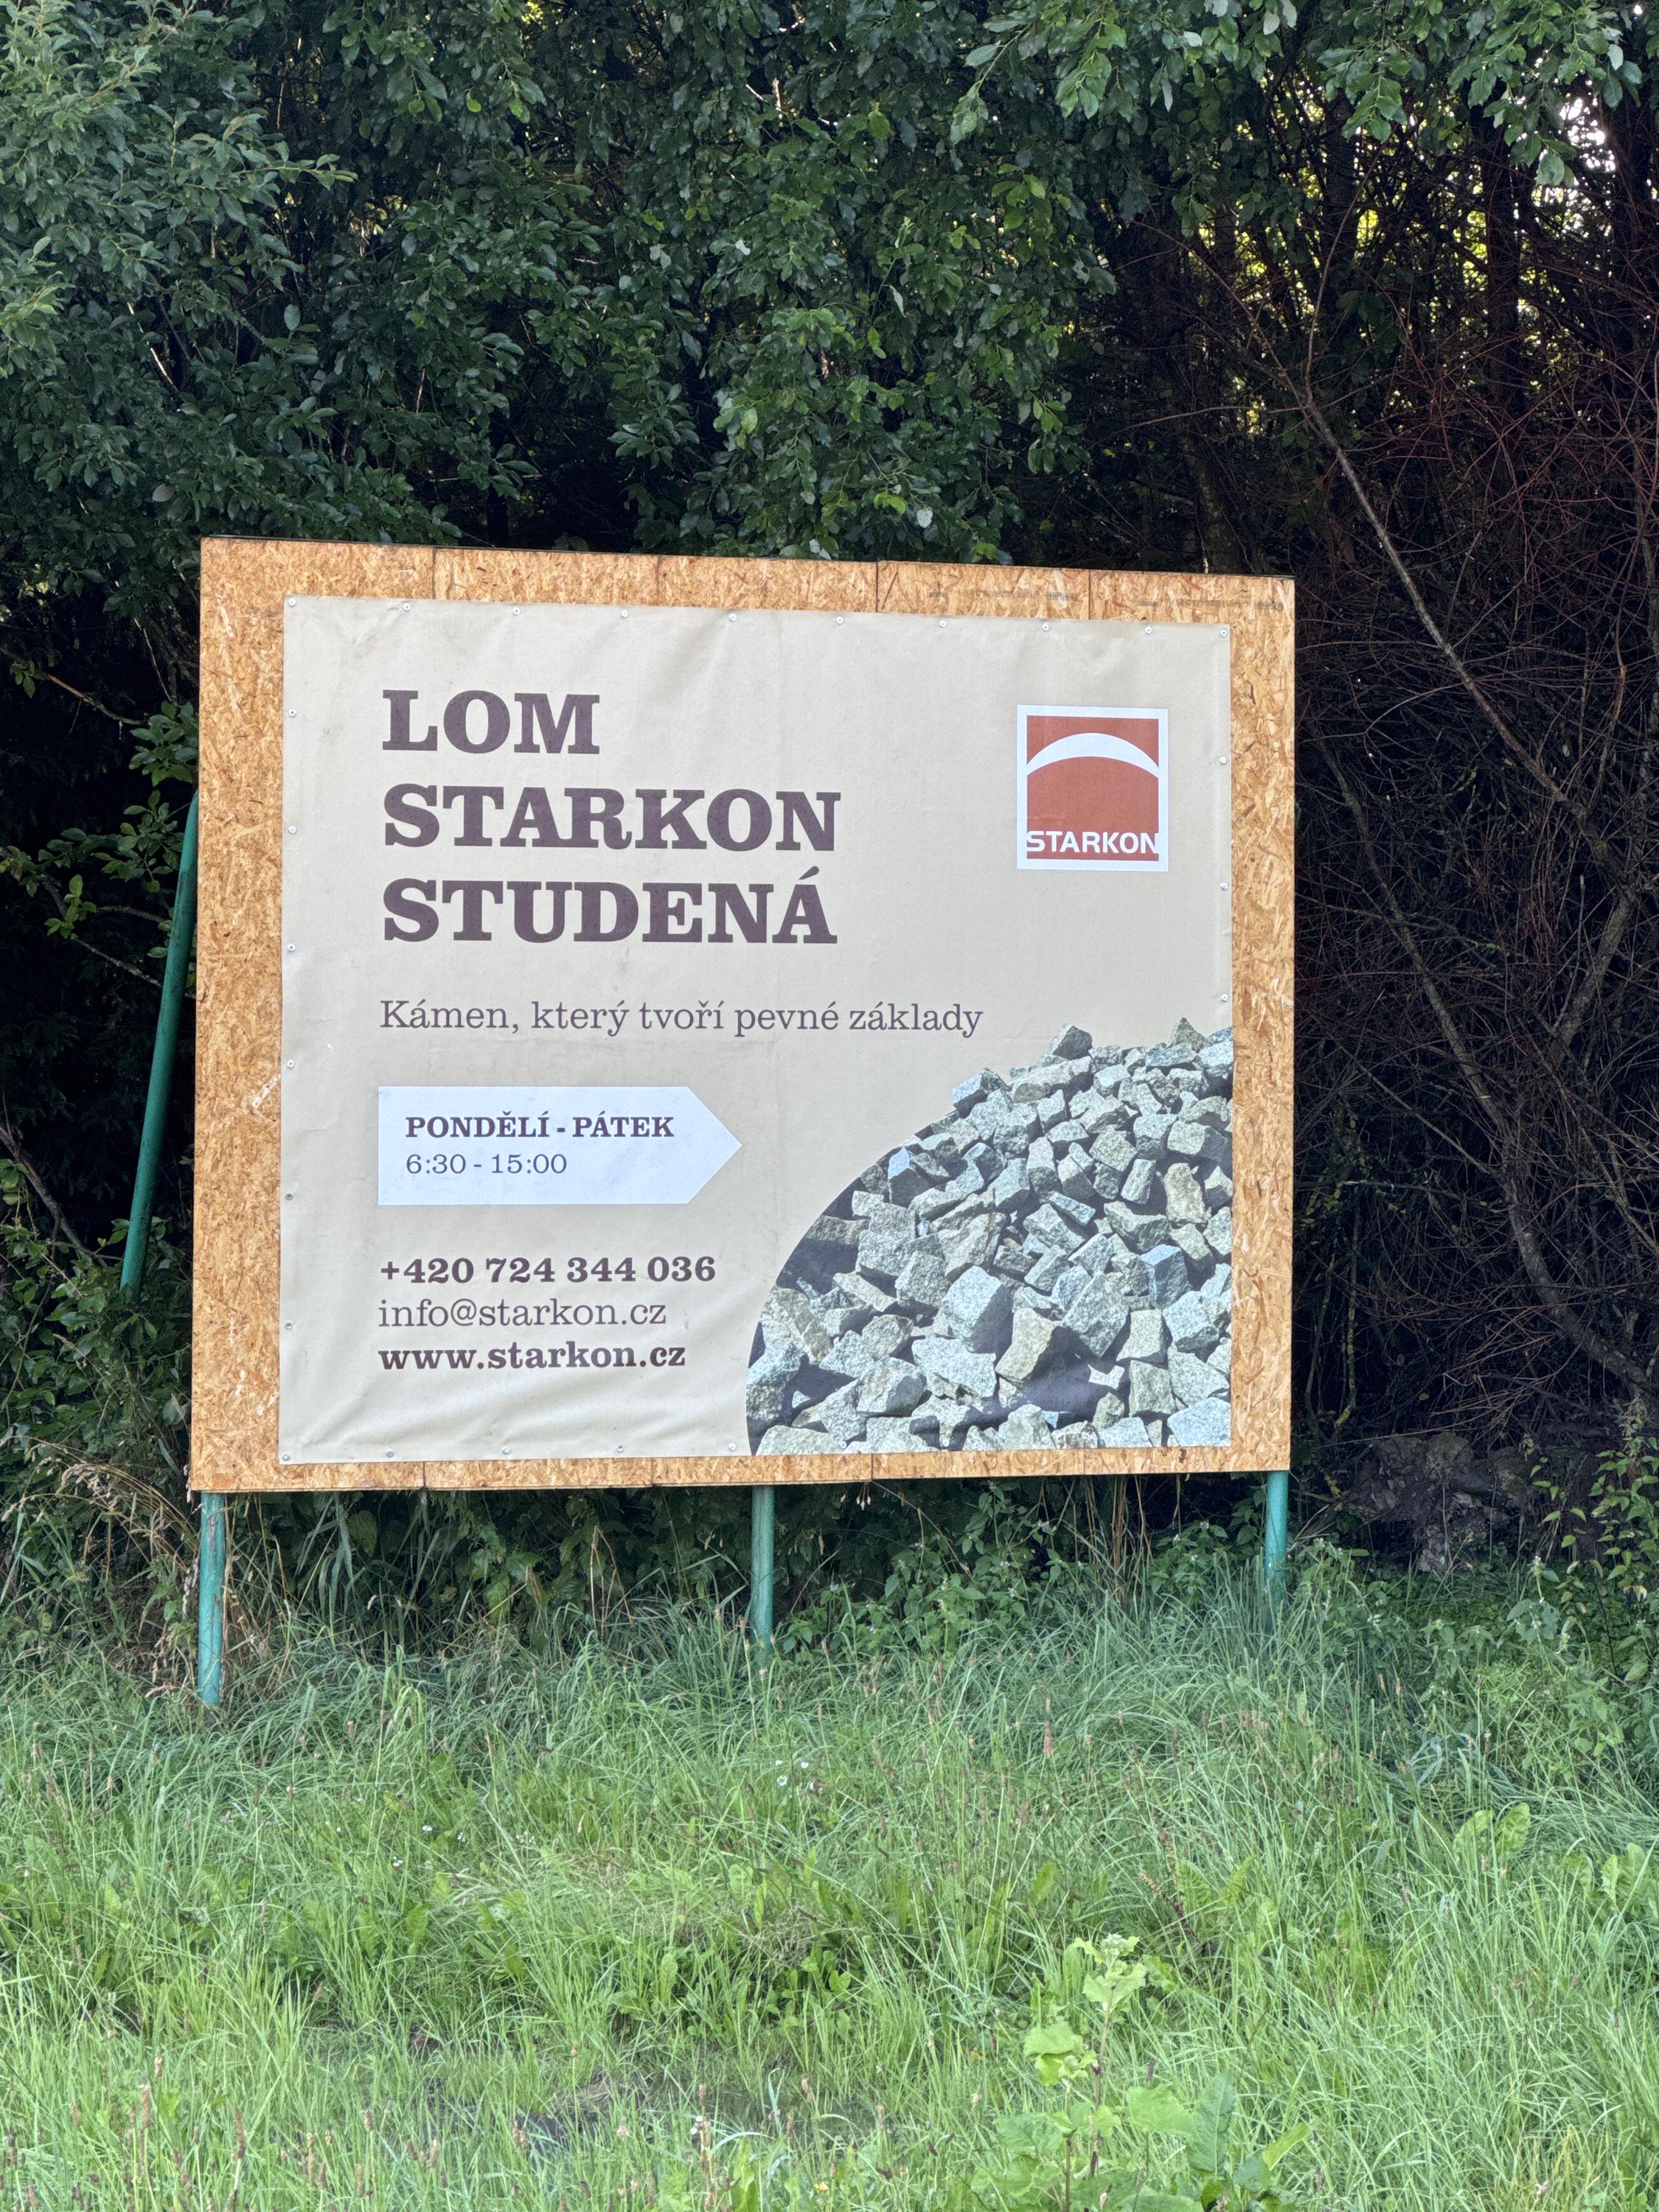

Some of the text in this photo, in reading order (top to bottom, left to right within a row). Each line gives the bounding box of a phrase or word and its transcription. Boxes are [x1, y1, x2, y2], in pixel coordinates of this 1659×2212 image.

[382, 689, 600, 755] LOM
[383, 783, 841, 852] STARKON
[1027, 830, 1160, 854] STARKON
[383, 866, 838, 945] STUDENÁ
[380, 998, 984, 1038] Kámen, který tvoří pevné základy
[405, 1110, 550, 1138] PONDĚLÍ
[572, 1110, 675, 1138] PÁTEK
[406, 1153, 467, 1175] 6:30
[491, 1153, 567, 1174] 15:00
[380, 1256, 716, 1284] +420 724 344 036
[378, 1298, 667, 1327] info@starkon.cz
[378, 1340, 686, 1370] www.starkon.cz
